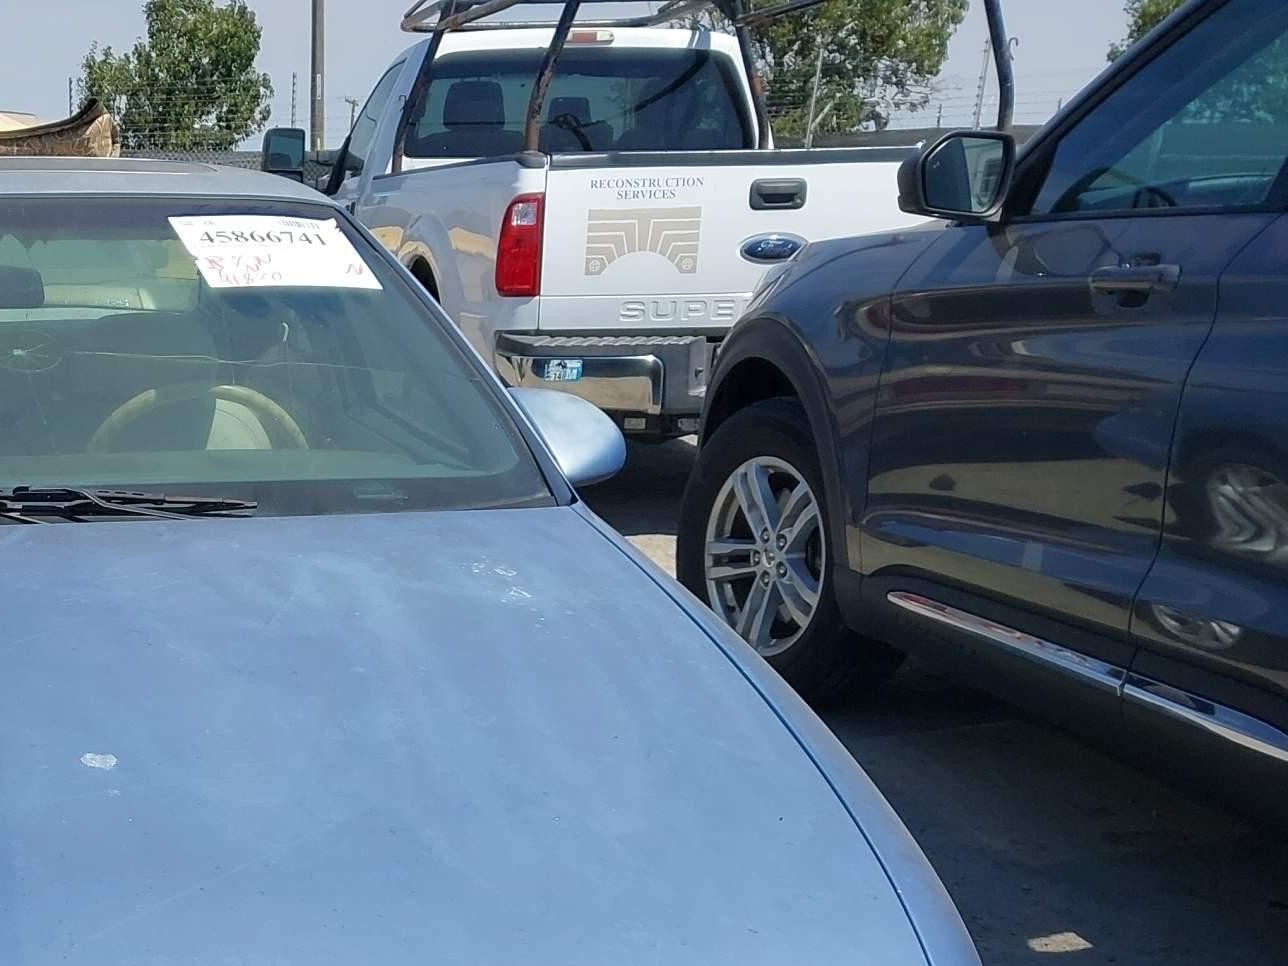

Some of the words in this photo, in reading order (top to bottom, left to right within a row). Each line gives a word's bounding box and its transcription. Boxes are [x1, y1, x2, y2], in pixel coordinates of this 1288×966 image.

[590, 176, 704, 189] RECONSTRUCTION
[616, 188, 676, 200] SERVICES
[200, 230, 327, 246] 45866741
[618, 299, 749, 322] SUPE
